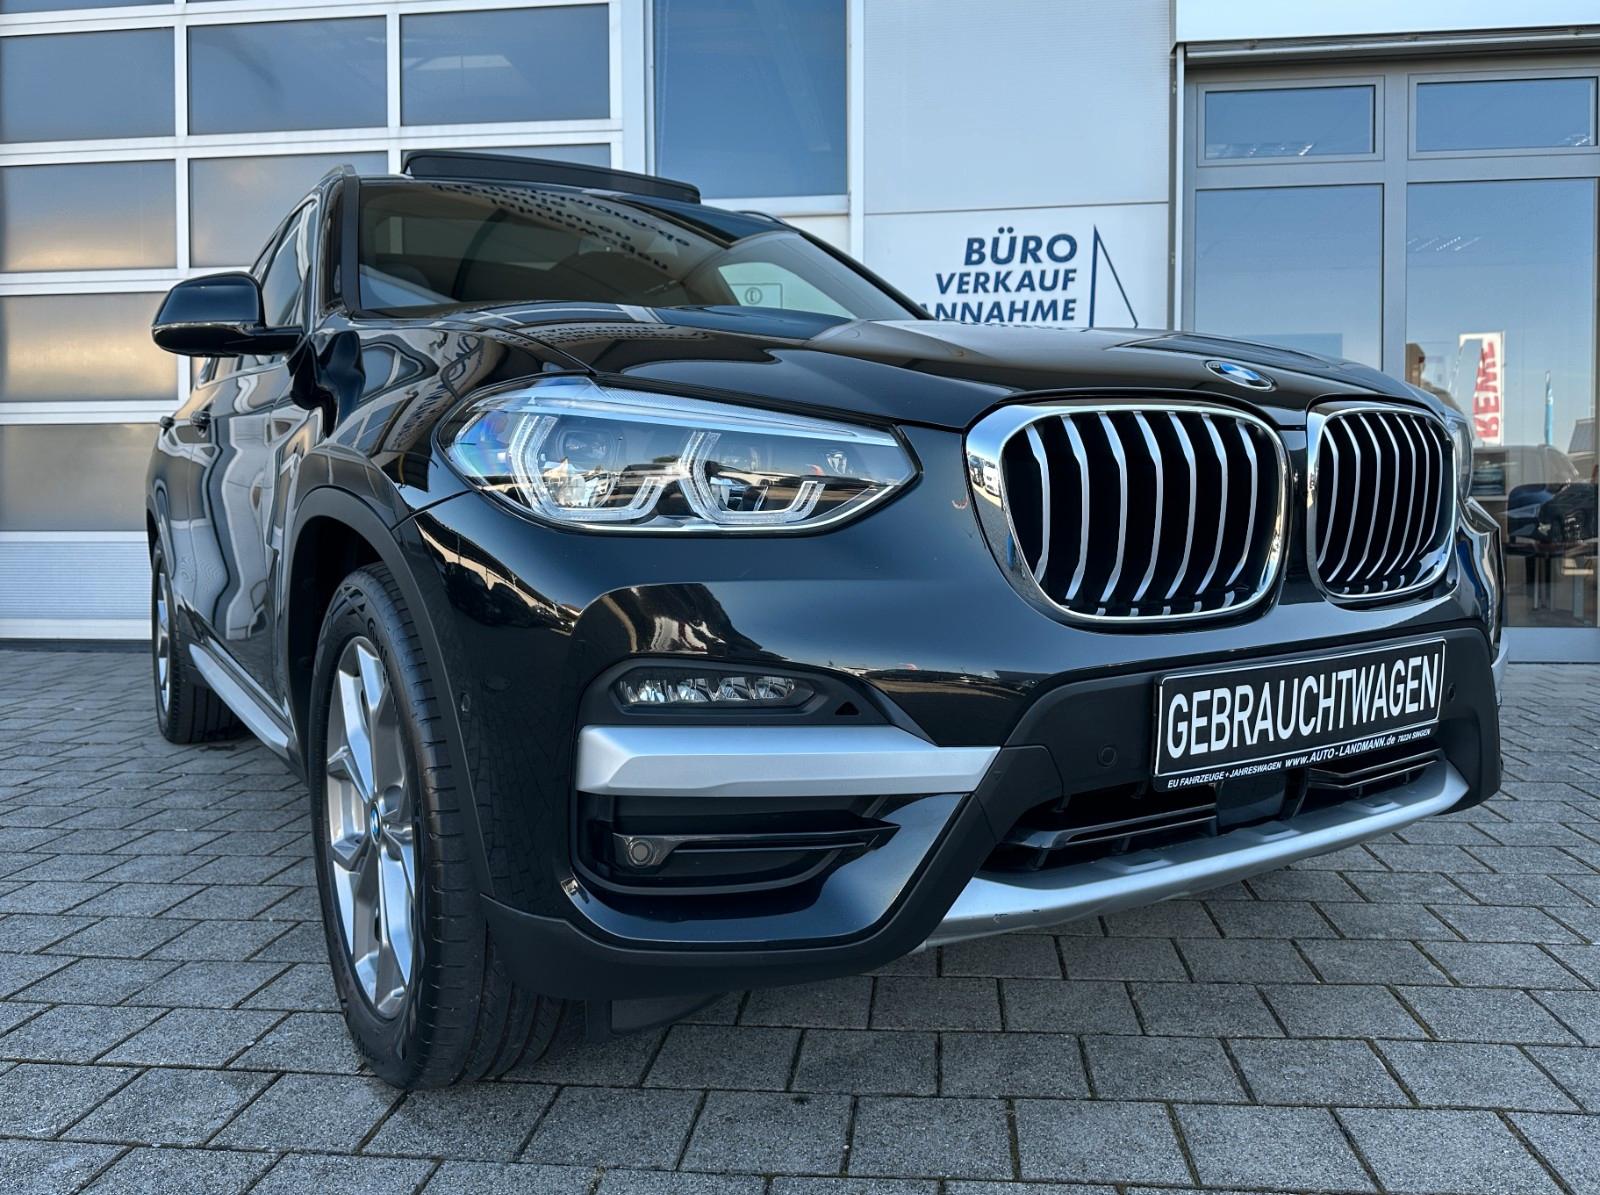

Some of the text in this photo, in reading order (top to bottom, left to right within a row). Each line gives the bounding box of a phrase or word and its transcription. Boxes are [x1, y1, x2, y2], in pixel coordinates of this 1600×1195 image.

[964, 226, 1078, 266] BÜRO
[936, 268, 1077, 295] VERKAUF
[920, 298, 1077, 323] NNAHME
[1166, 653, 1440, 759] GEBRAUCHTWAGEN
[1167, 778, 1180, 789] EU
[1179, 771, 1226, 787] FAHRZEUGE
[1229, 761, 1282, 778] JAHRESWAGEN
[1411, 728, 1432, 740] SINGEN
